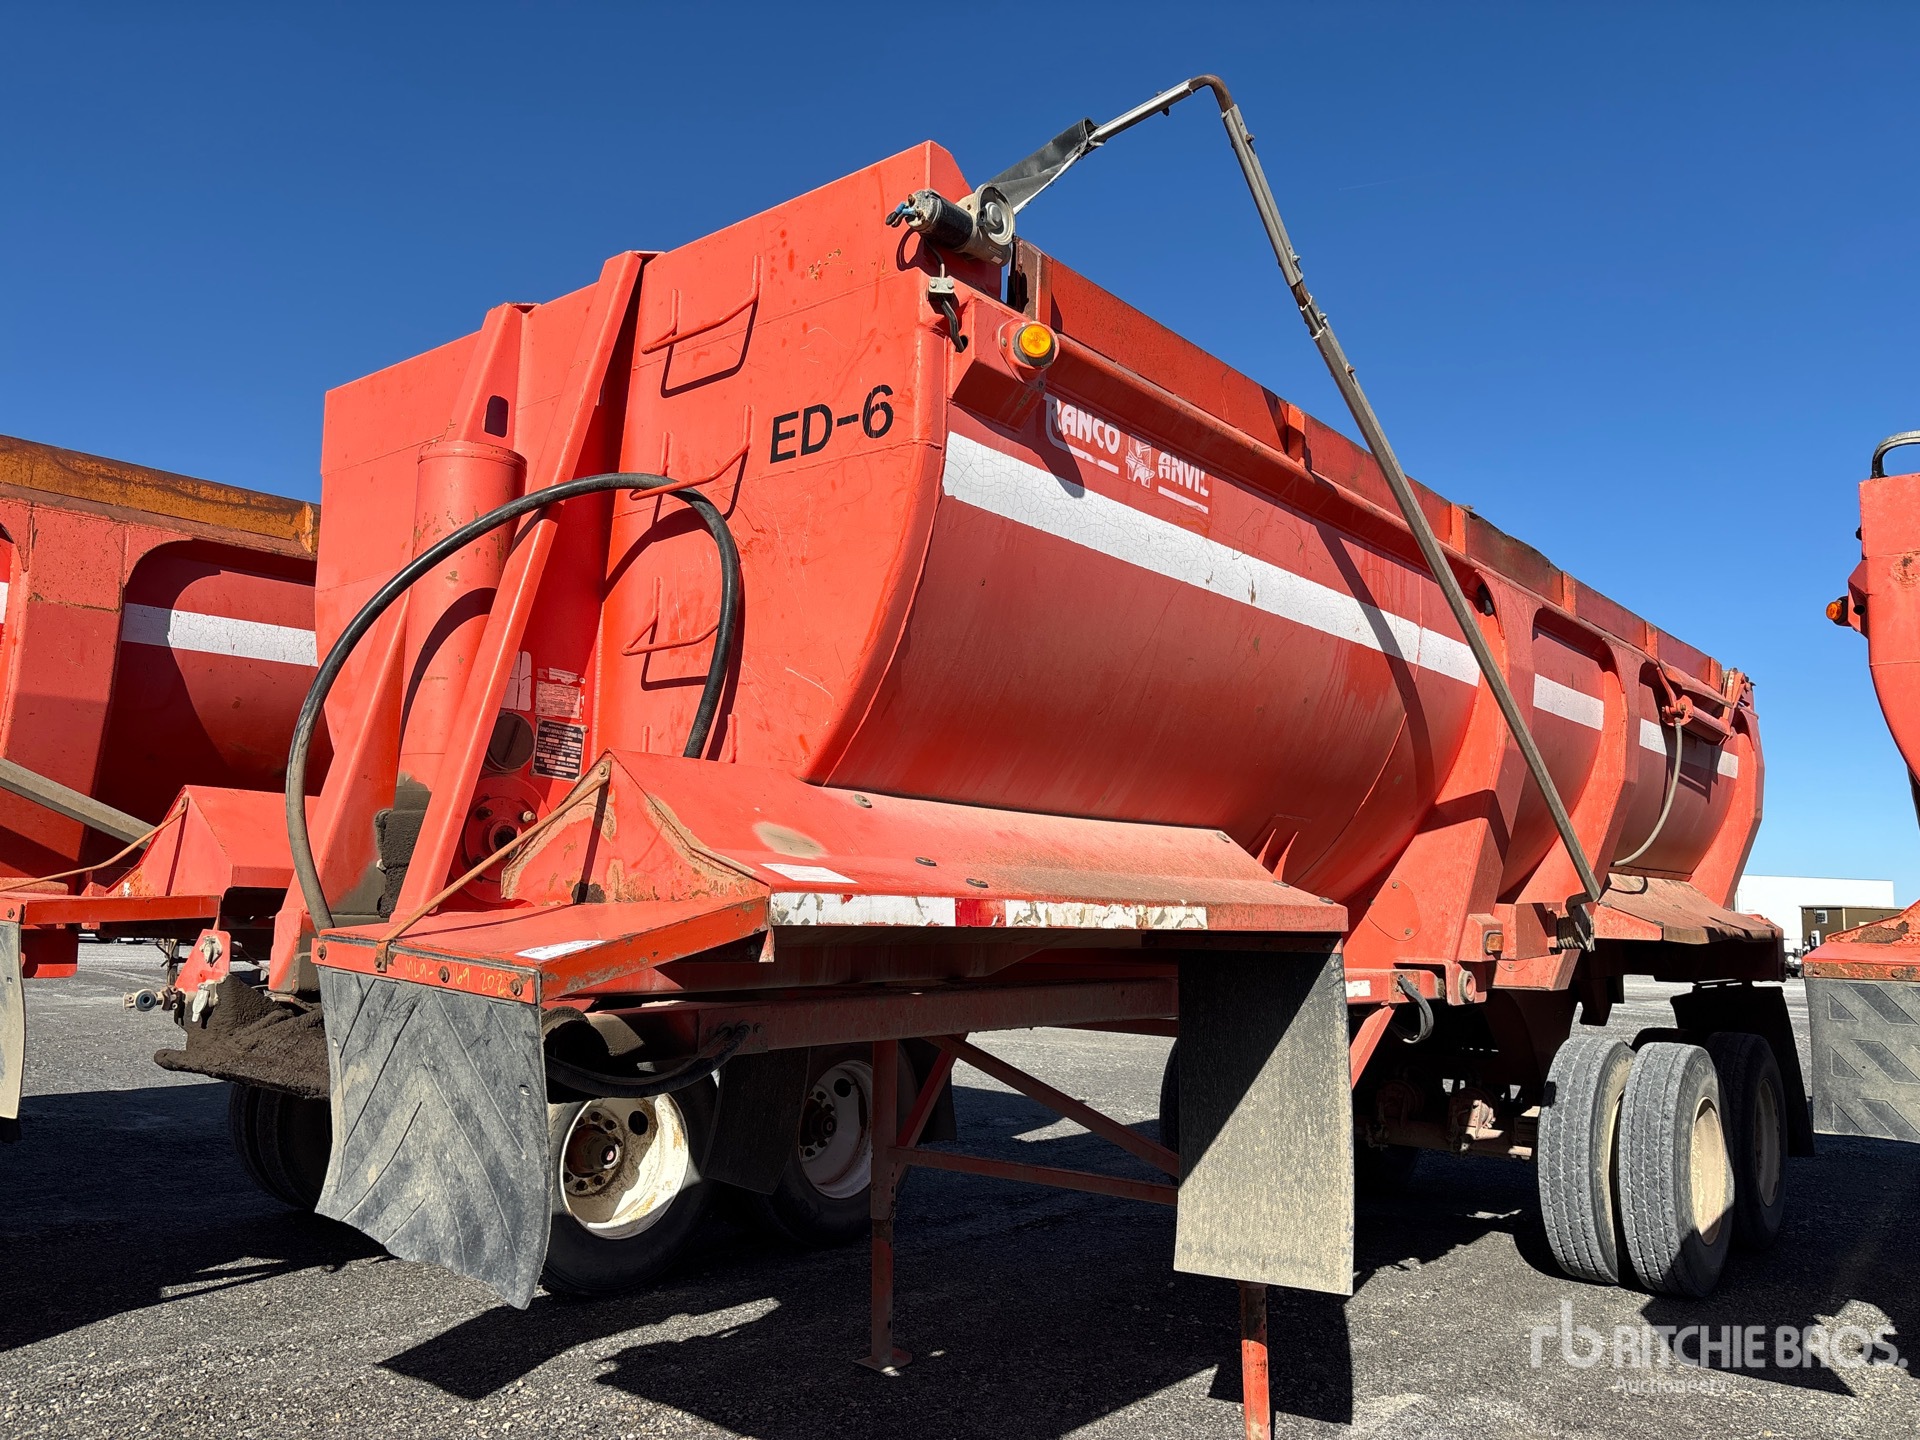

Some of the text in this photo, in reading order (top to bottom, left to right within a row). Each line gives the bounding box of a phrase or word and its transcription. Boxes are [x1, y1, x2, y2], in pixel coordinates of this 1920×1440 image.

[770, 385, 894, 464] ED-6
[1045, 396, 1210, 498] RANCO ANVIL
